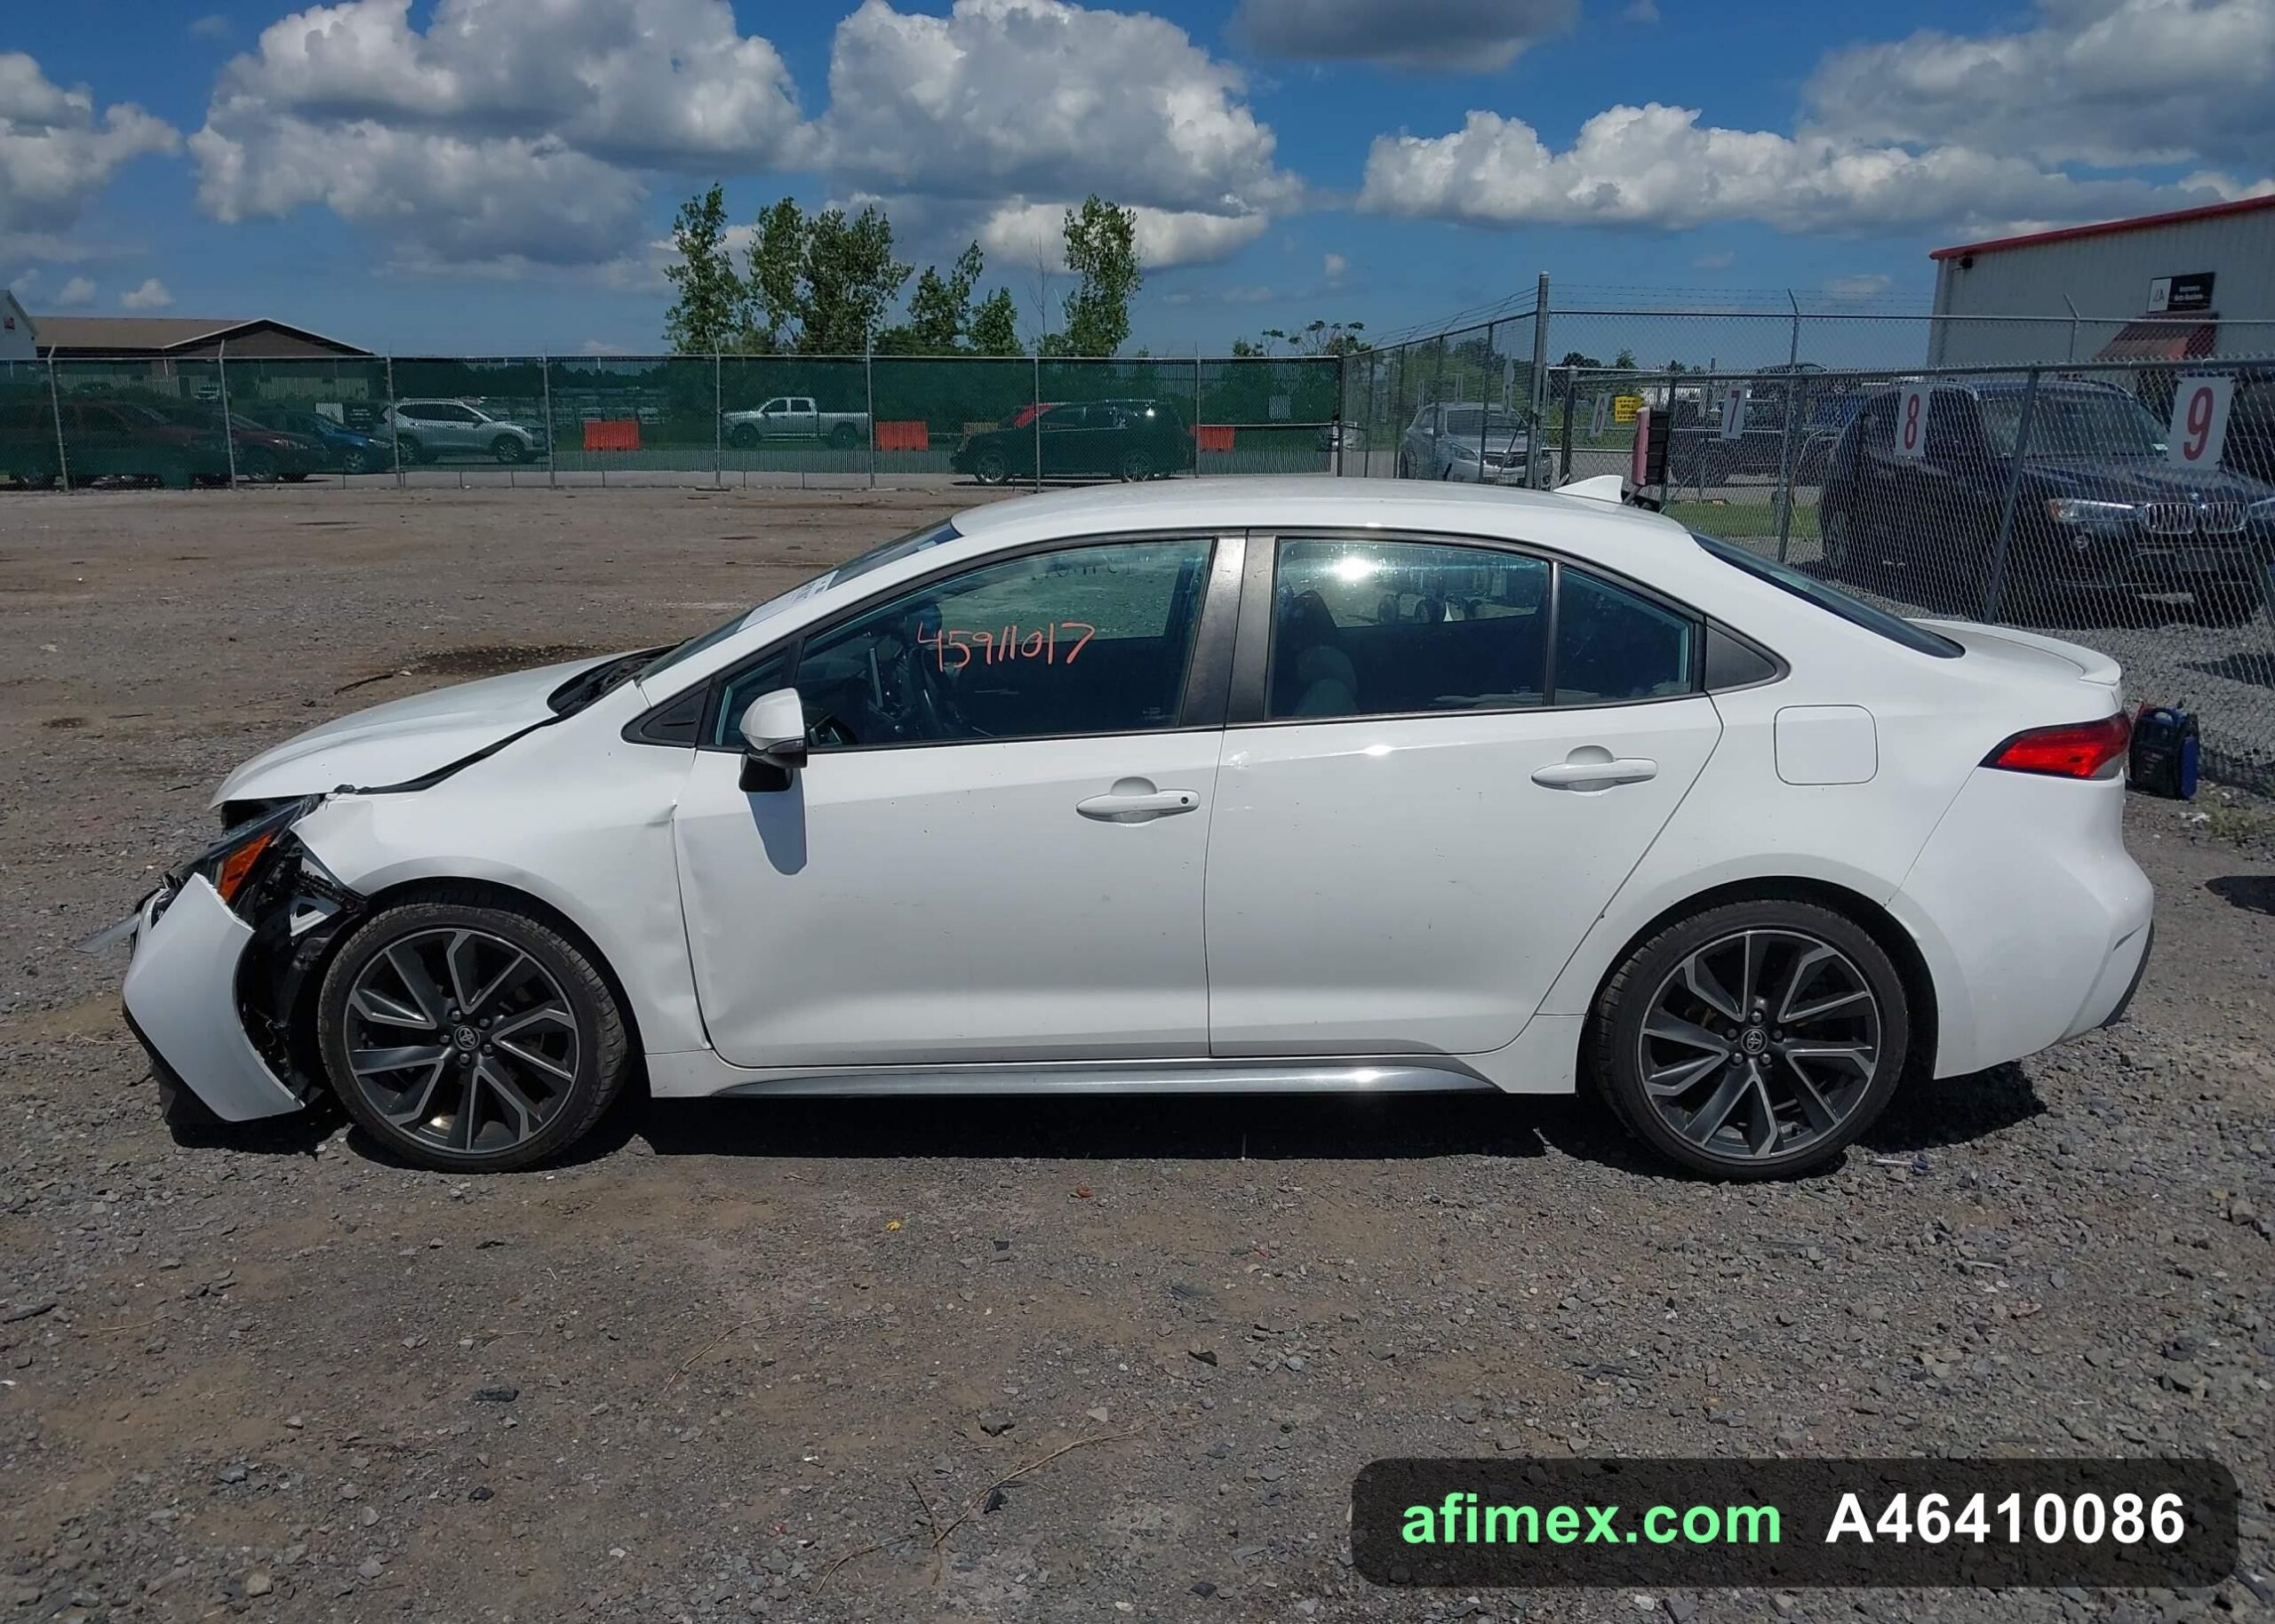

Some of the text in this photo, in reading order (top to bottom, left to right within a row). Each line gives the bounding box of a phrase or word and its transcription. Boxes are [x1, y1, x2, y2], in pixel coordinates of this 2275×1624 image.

[1595, 397, 1605, 433] 6
[1728, 390, 1741, 434] 7
[1904, 394, 1920, 450] 8
[2183, 386, 2214, 461] 9
[918, 622, 1096, 673] 45911017
